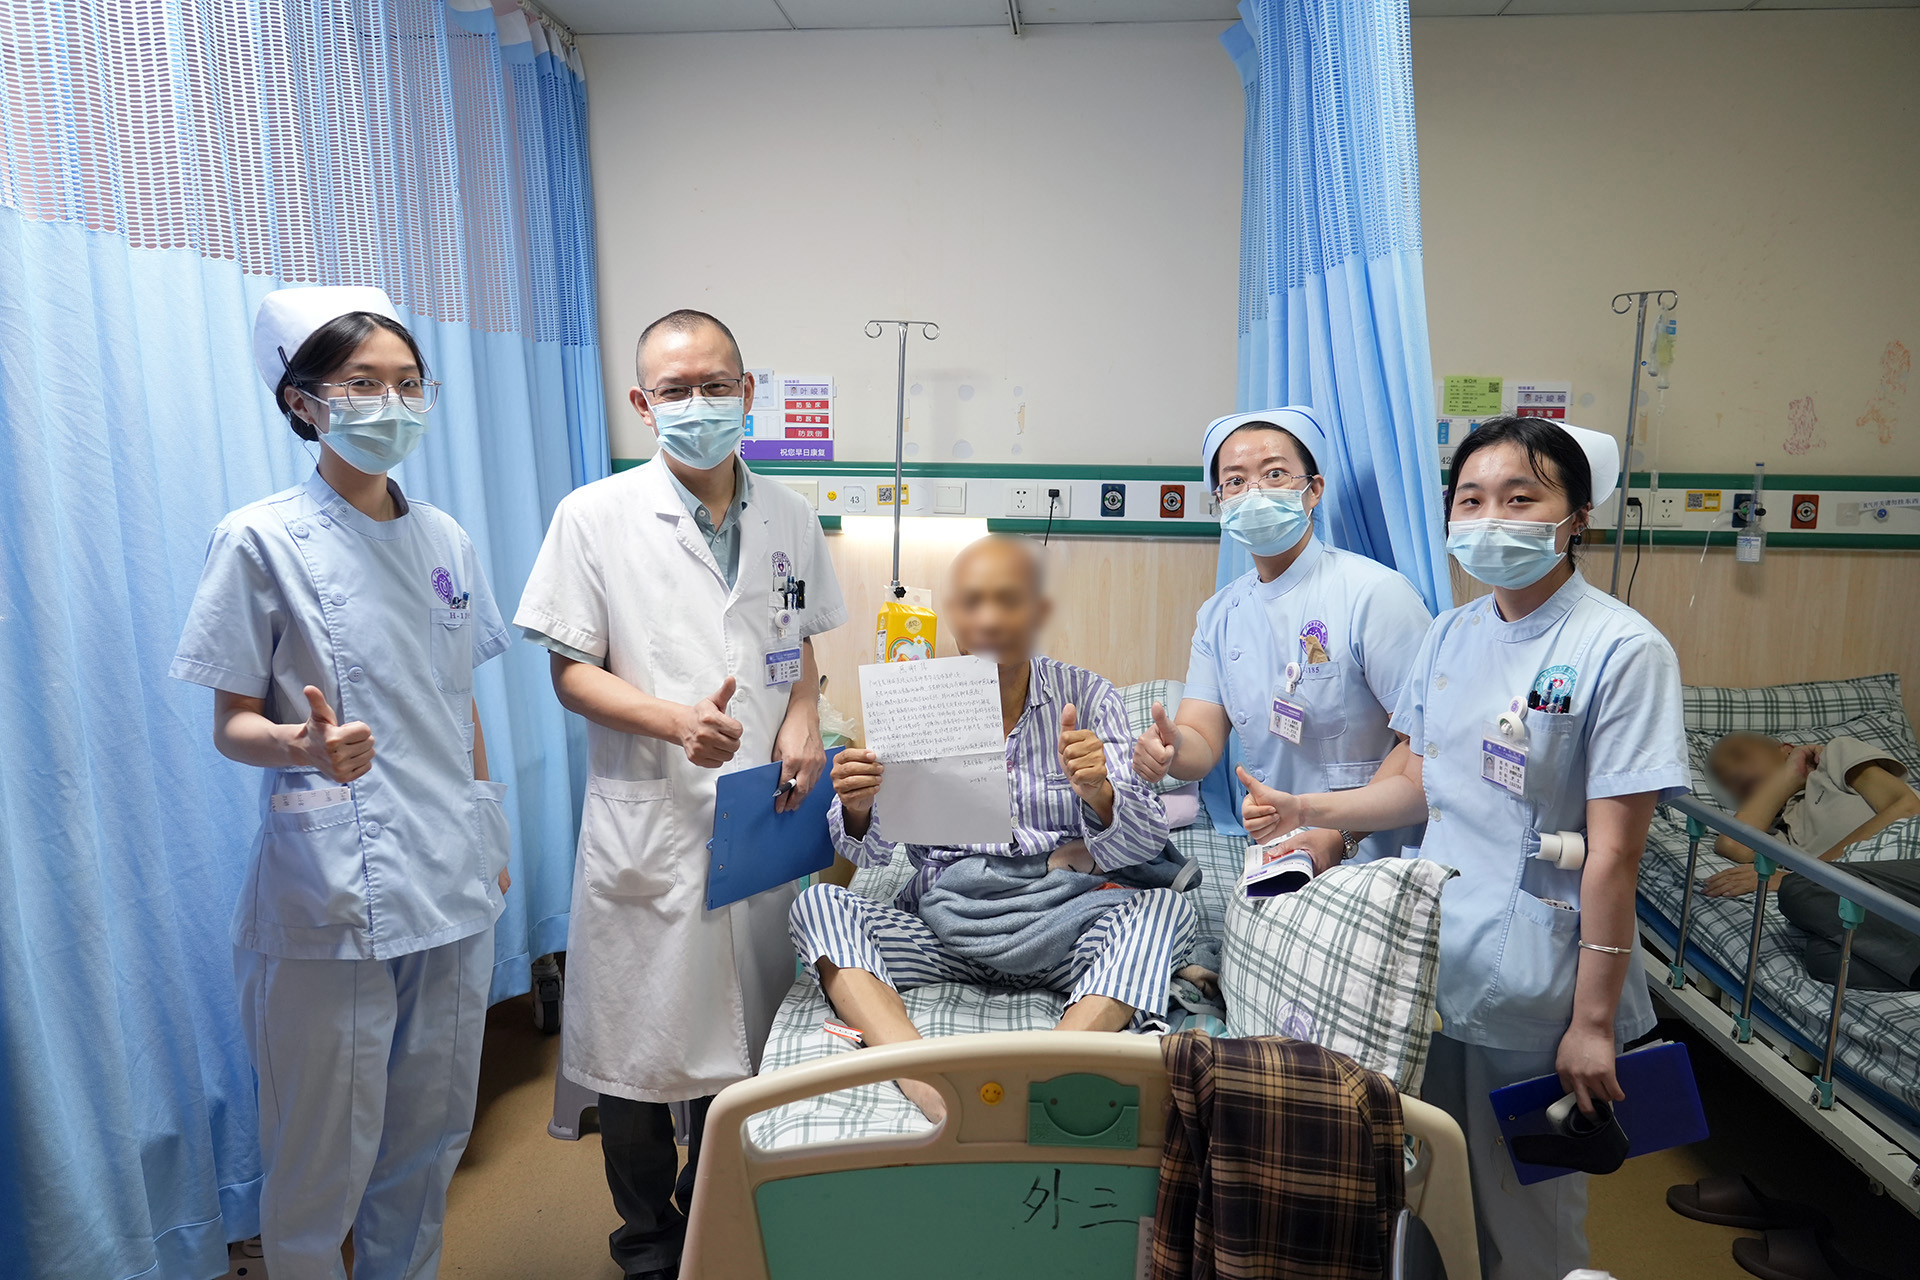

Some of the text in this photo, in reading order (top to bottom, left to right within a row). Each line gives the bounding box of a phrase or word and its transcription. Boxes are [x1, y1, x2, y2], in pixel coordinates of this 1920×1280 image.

[780, 448, 826, 457] 祝您早日康复
[1441, 456, 1452, 465] 42
[850, 496, 860, 504] 43
[1022, 1168, 1139, 1230] 外三
